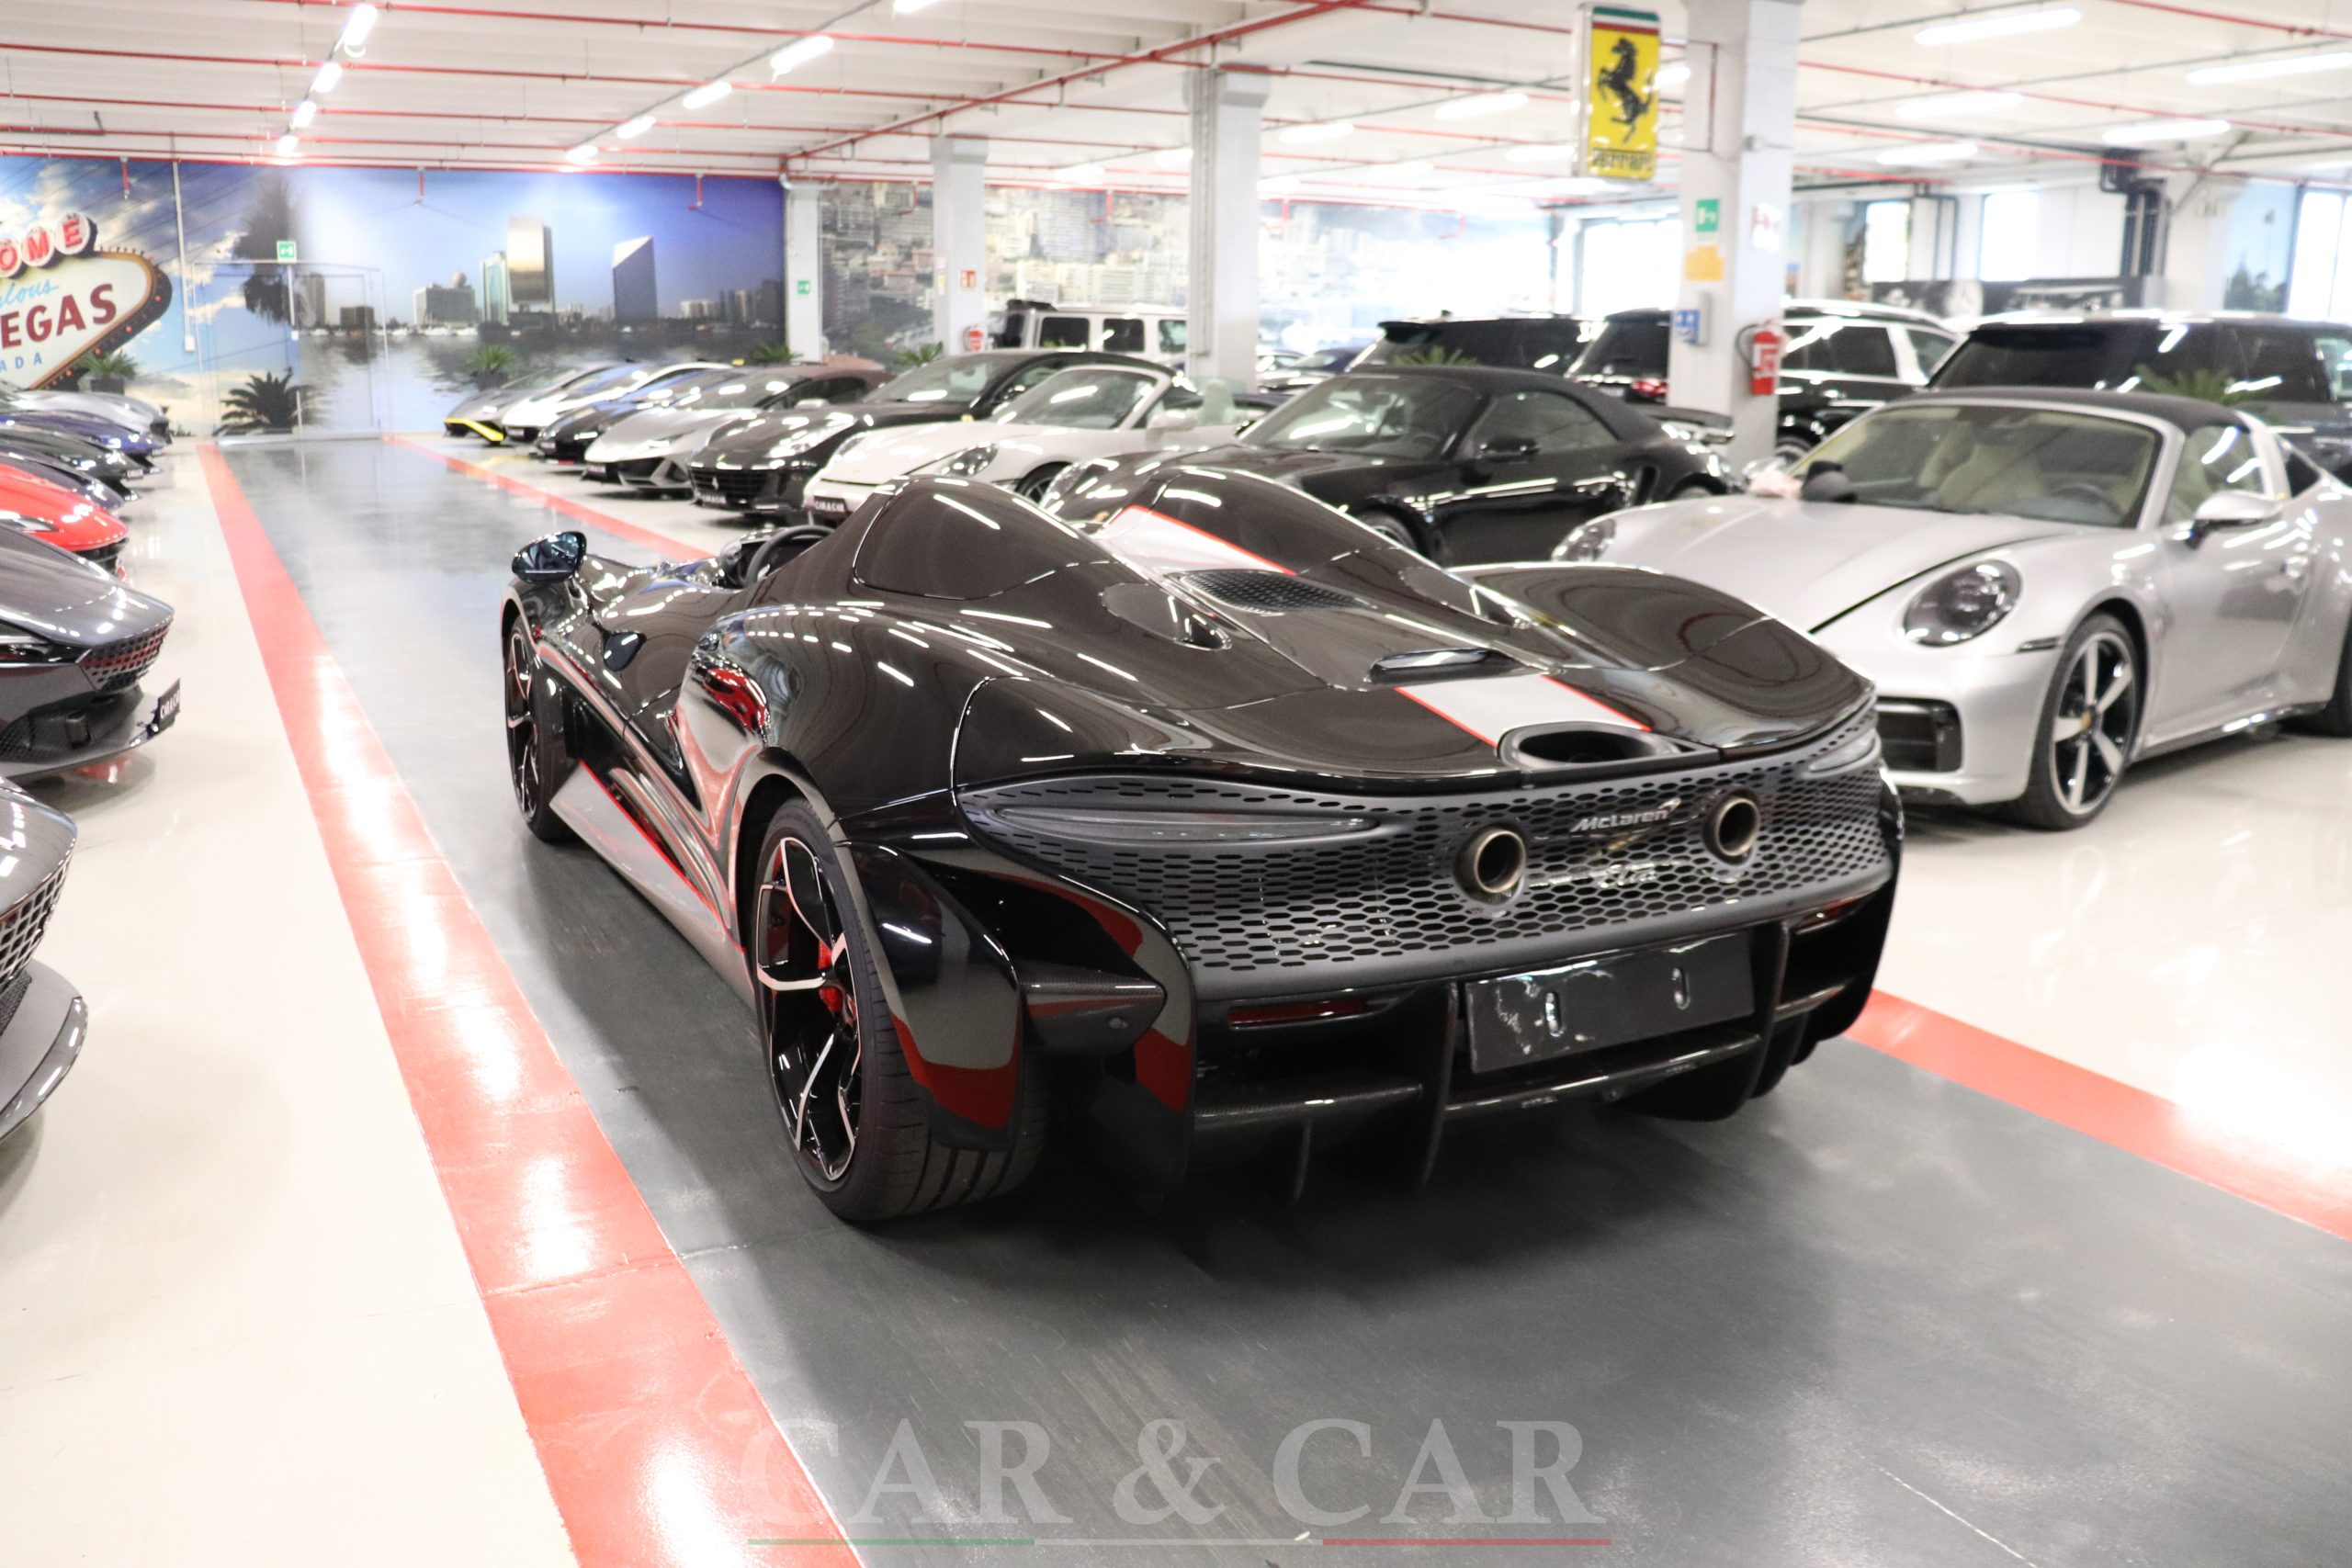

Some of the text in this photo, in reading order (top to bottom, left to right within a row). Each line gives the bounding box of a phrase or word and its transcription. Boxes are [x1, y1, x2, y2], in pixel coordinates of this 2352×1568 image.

[0, 279, 59, 307] lous
[1, 283, 117, 348] EGAS
[1570, 808, 1669, 832] McLaren
